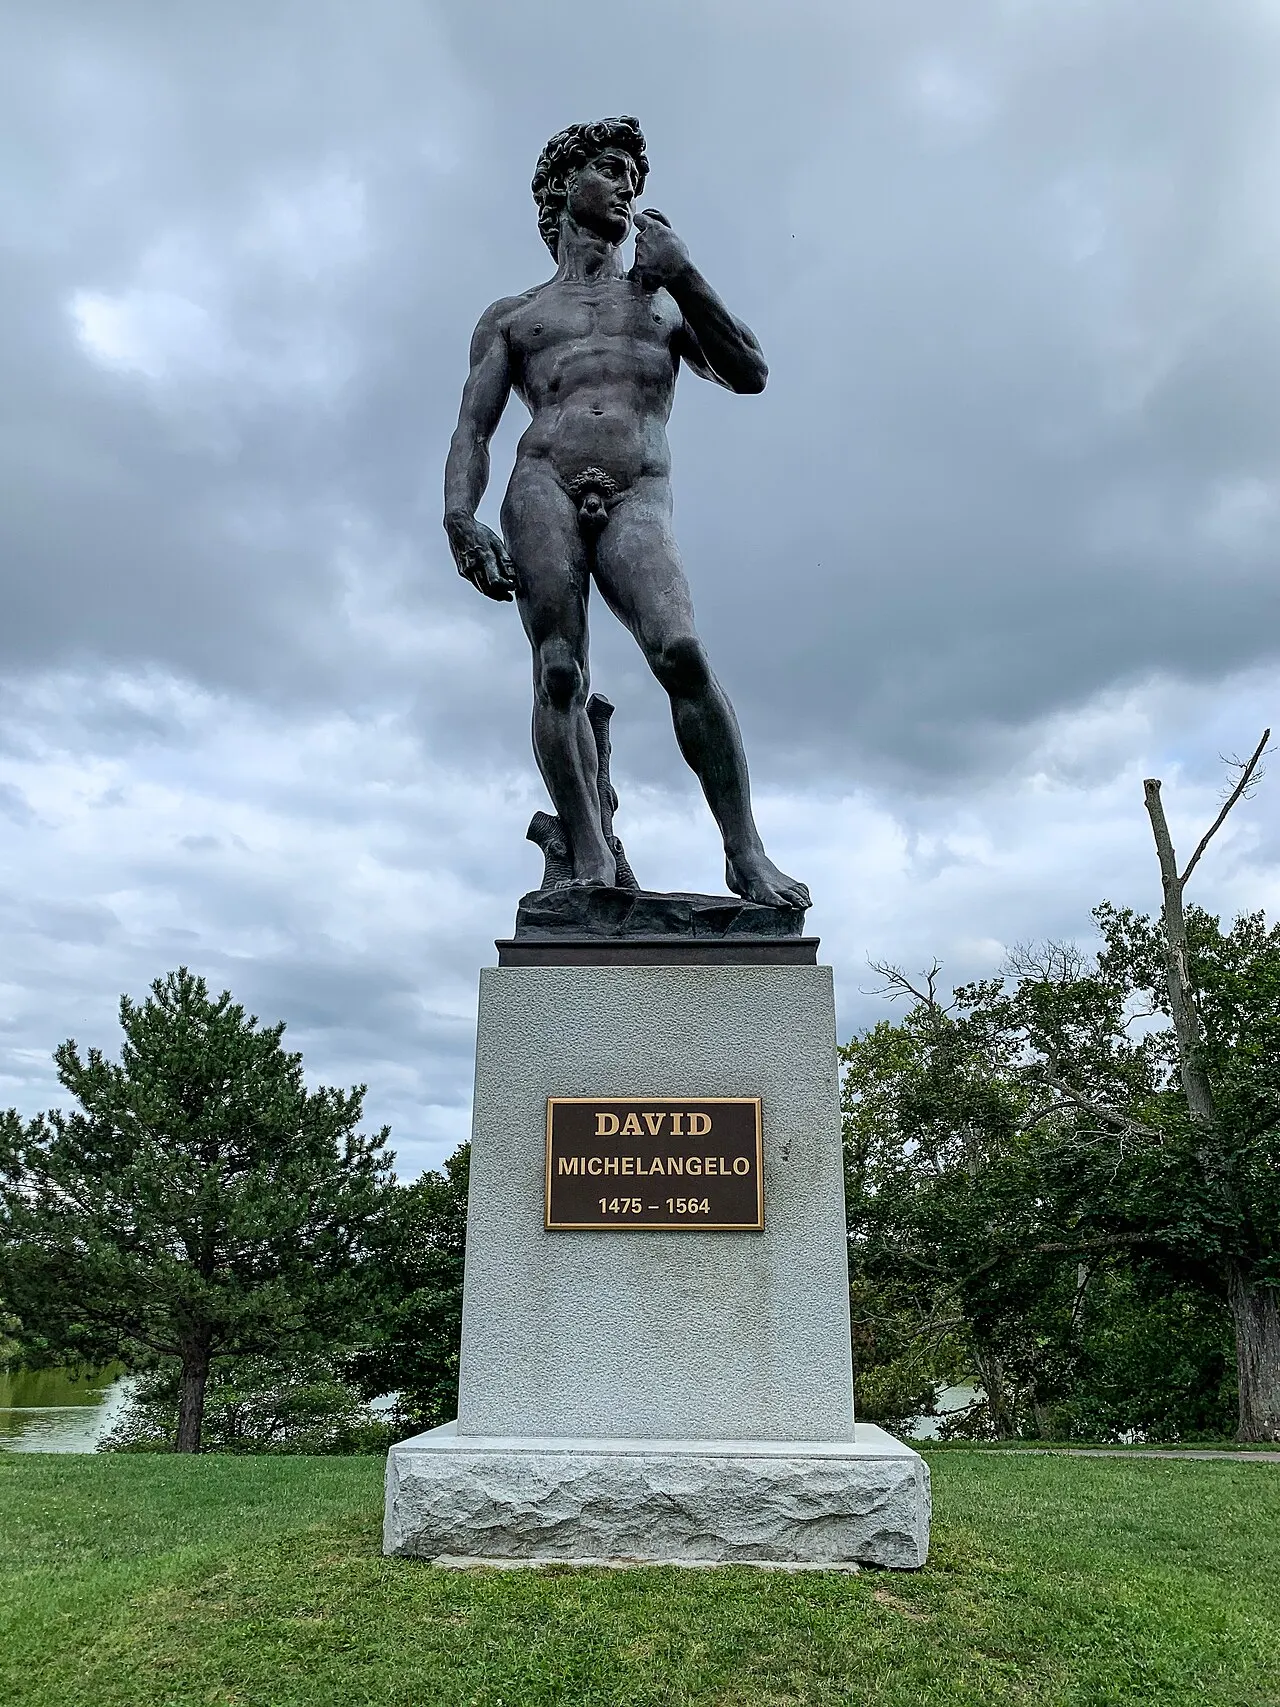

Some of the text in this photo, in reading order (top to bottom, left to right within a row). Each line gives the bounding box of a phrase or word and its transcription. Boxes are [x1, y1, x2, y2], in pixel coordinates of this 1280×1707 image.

[594, 1112, 712, 1136] DAVID
[558, 1156, 750, 1176] MICHELANGELO
[598, 1197, 643, 1214] 1475
[665, 1197, 711, 1214] 1564
